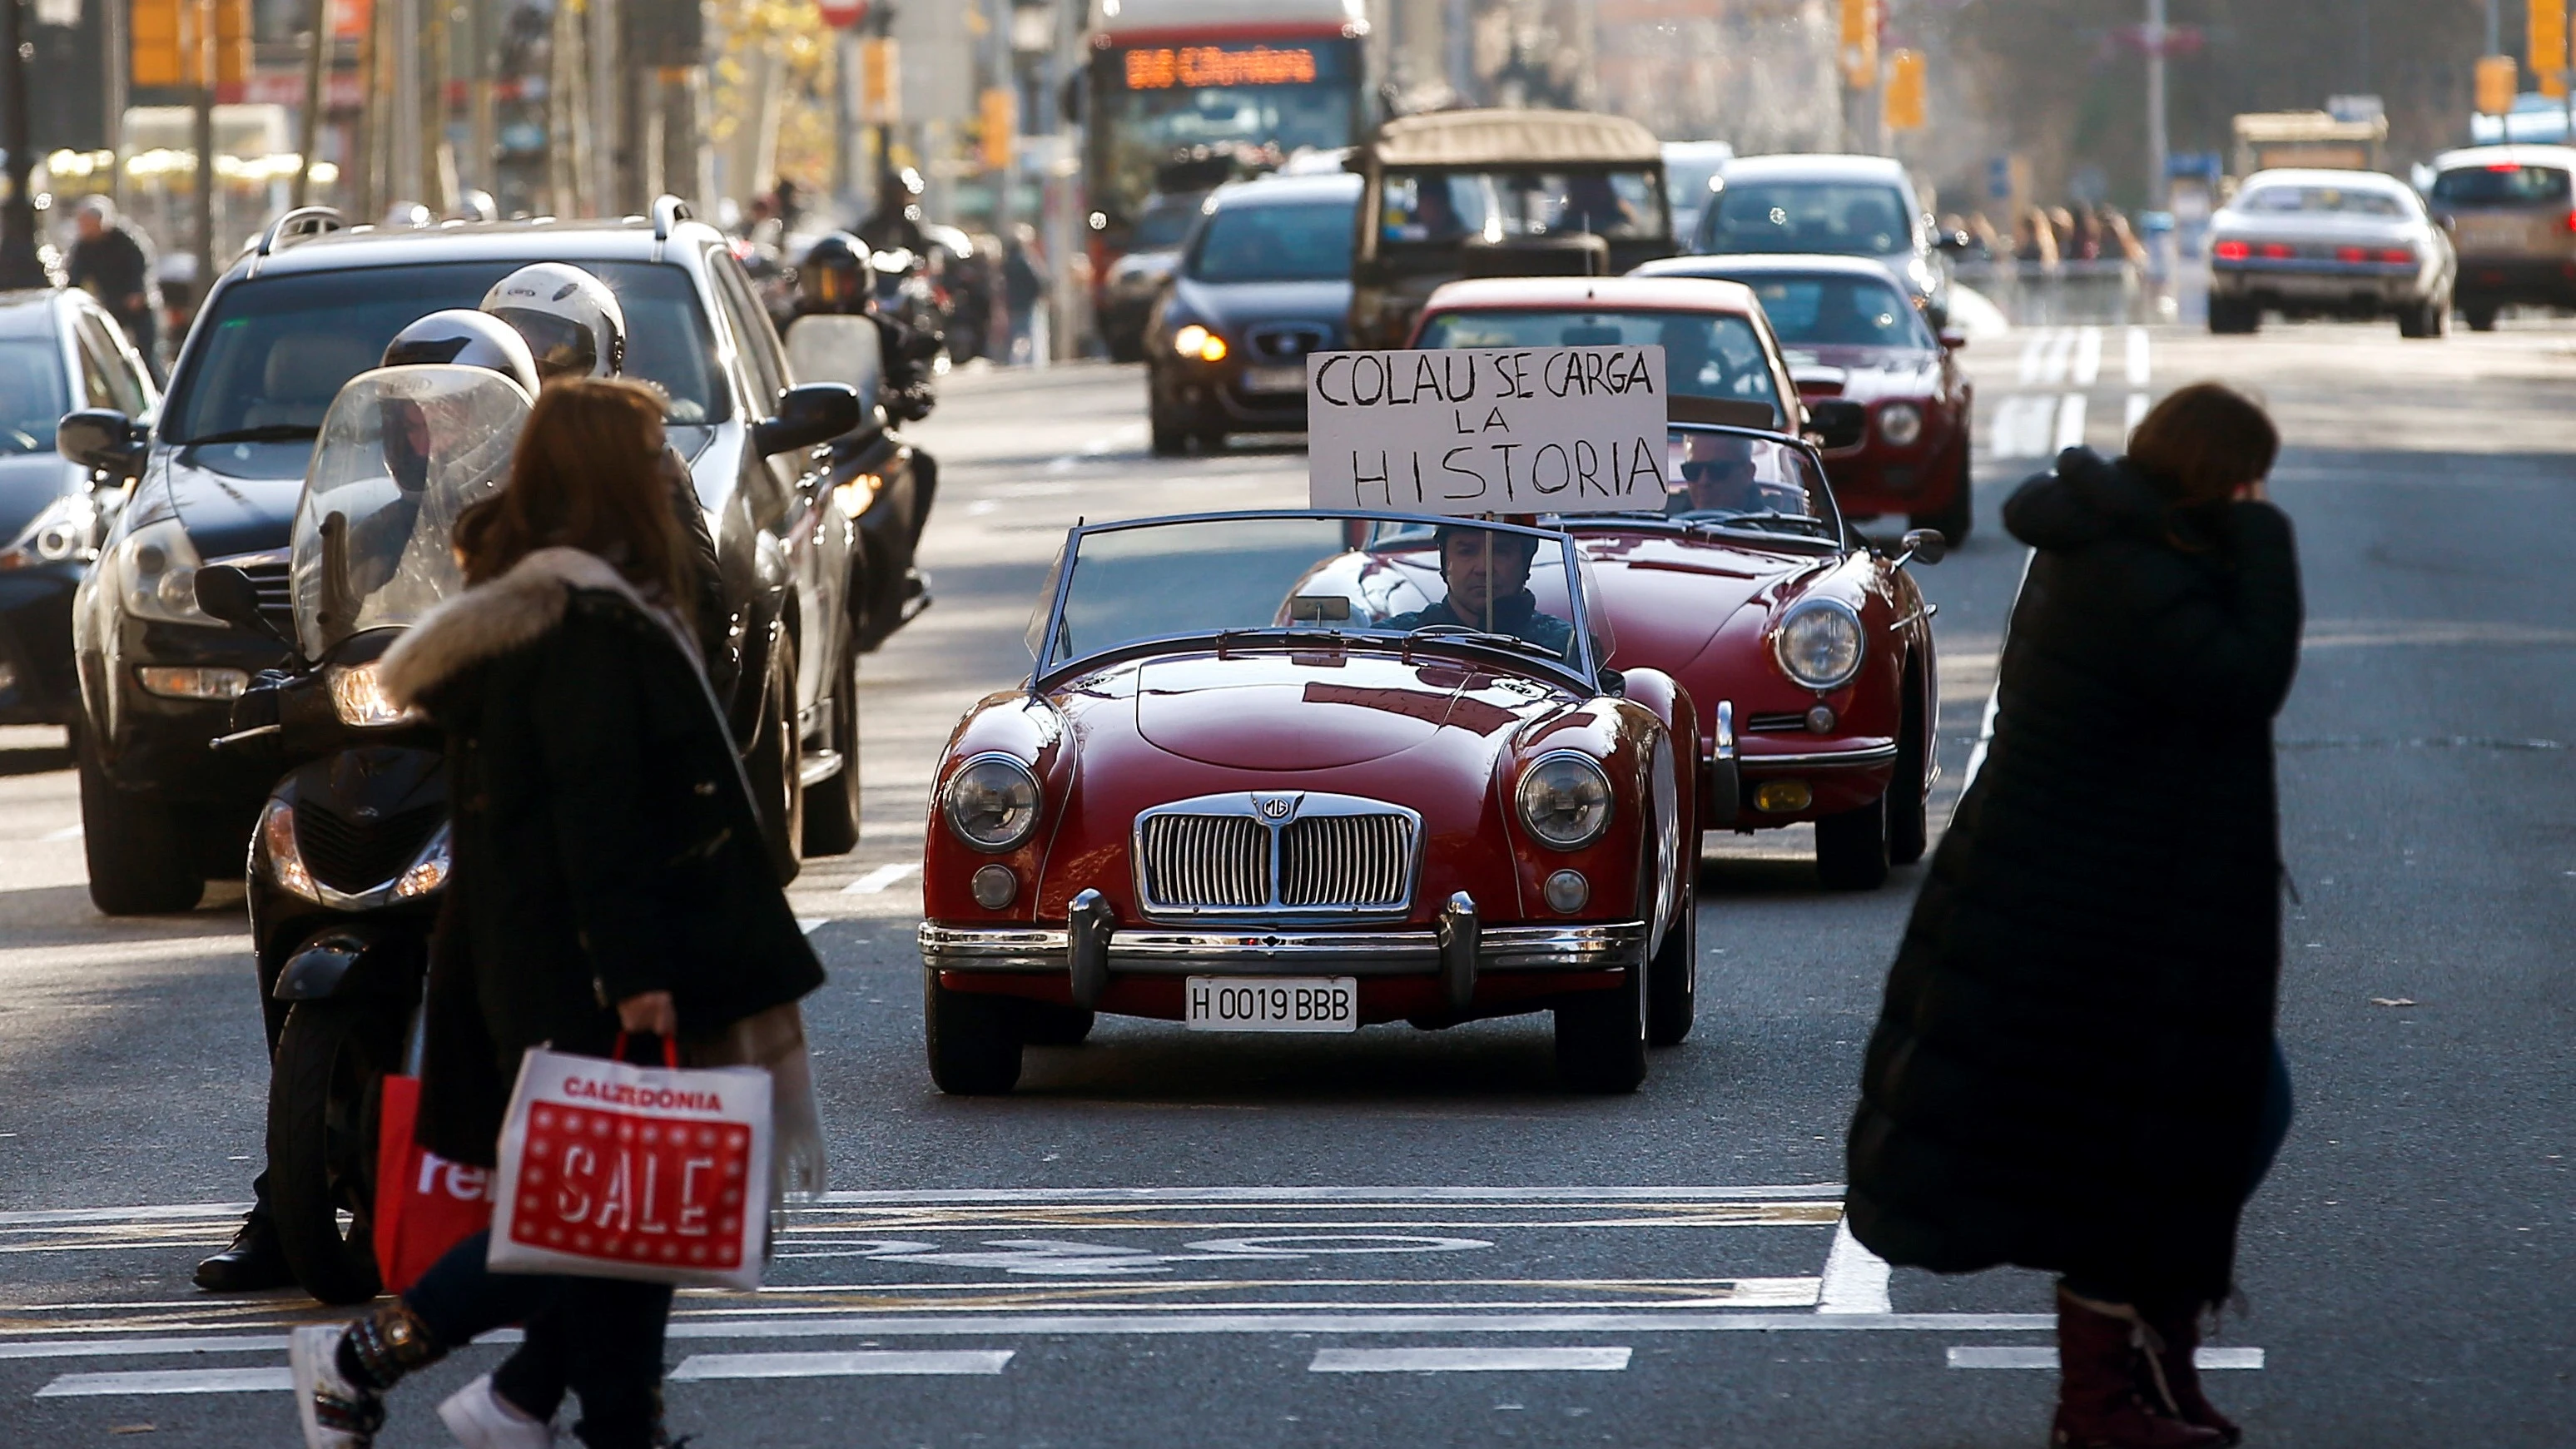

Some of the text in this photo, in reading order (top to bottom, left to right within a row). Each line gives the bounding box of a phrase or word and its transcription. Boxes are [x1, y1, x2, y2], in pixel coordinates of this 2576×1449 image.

[1316, 354, 1476, 406] COLAU
[1544, 350, 1654, 398] CARGA
[1455, 406, 1510, 434] LA
[1352, 436, 1668, 506] HISTORIA
[1265, 799, 1287, 816] MG
[1192, 987, 1350, 1021] H 0019 BBB
[557, 1144, 715, 1237] SALE
